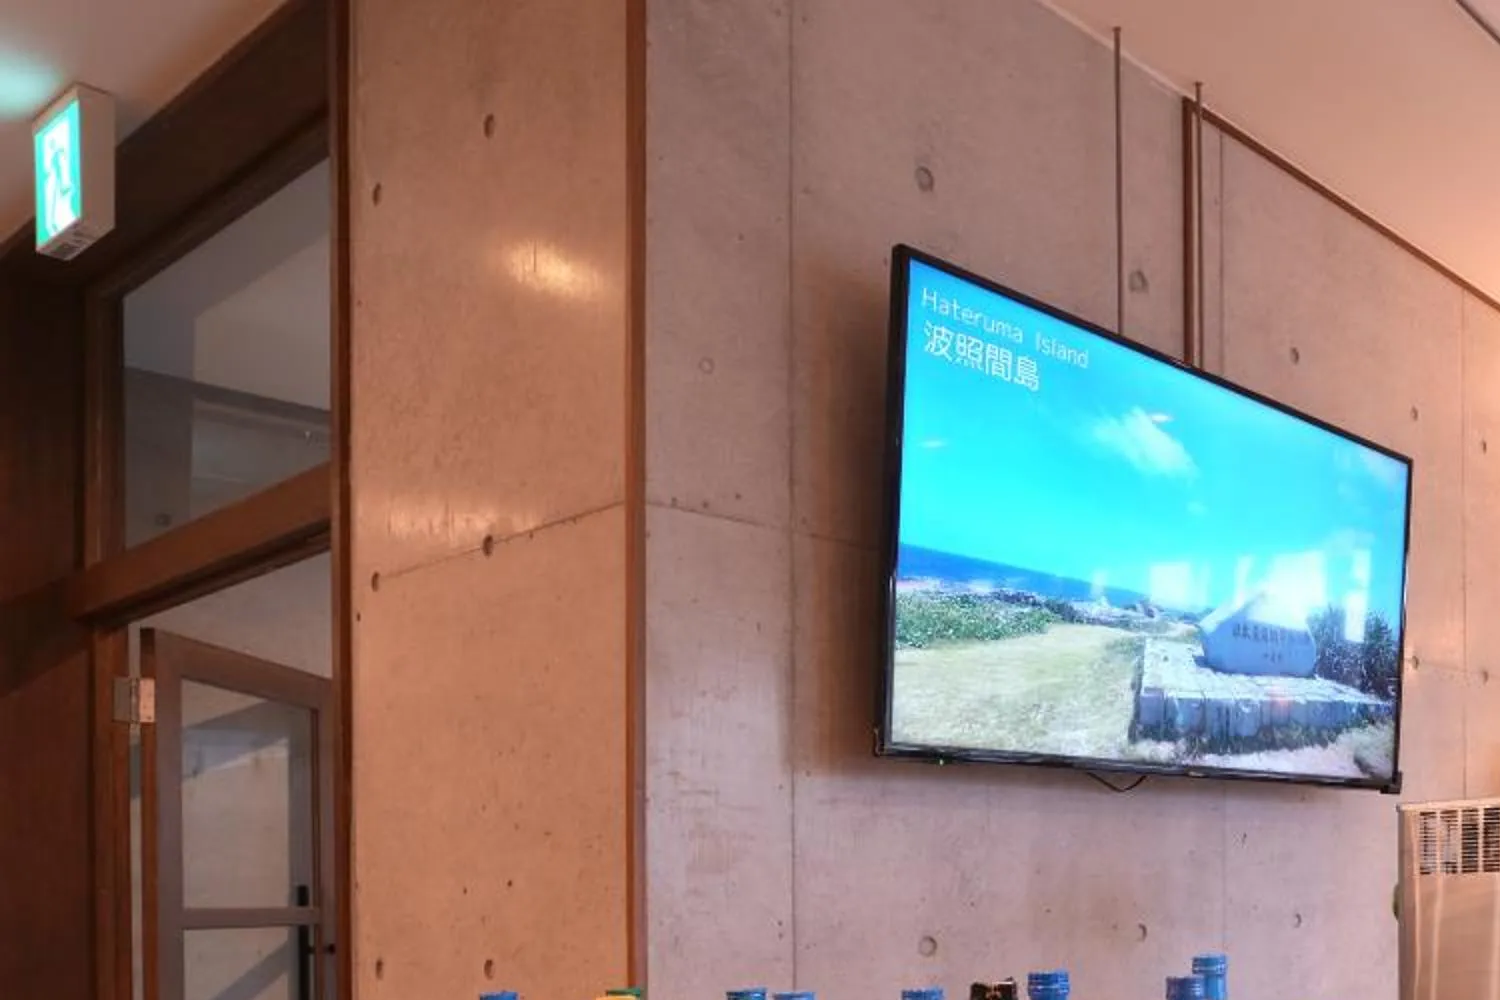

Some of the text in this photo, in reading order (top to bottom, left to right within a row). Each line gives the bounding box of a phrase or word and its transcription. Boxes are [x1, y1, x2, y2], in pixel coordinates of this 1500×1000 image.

[921, 287, 1090, 369] Hateruma Island
[923, 320, 1040, 392] 波照間島
